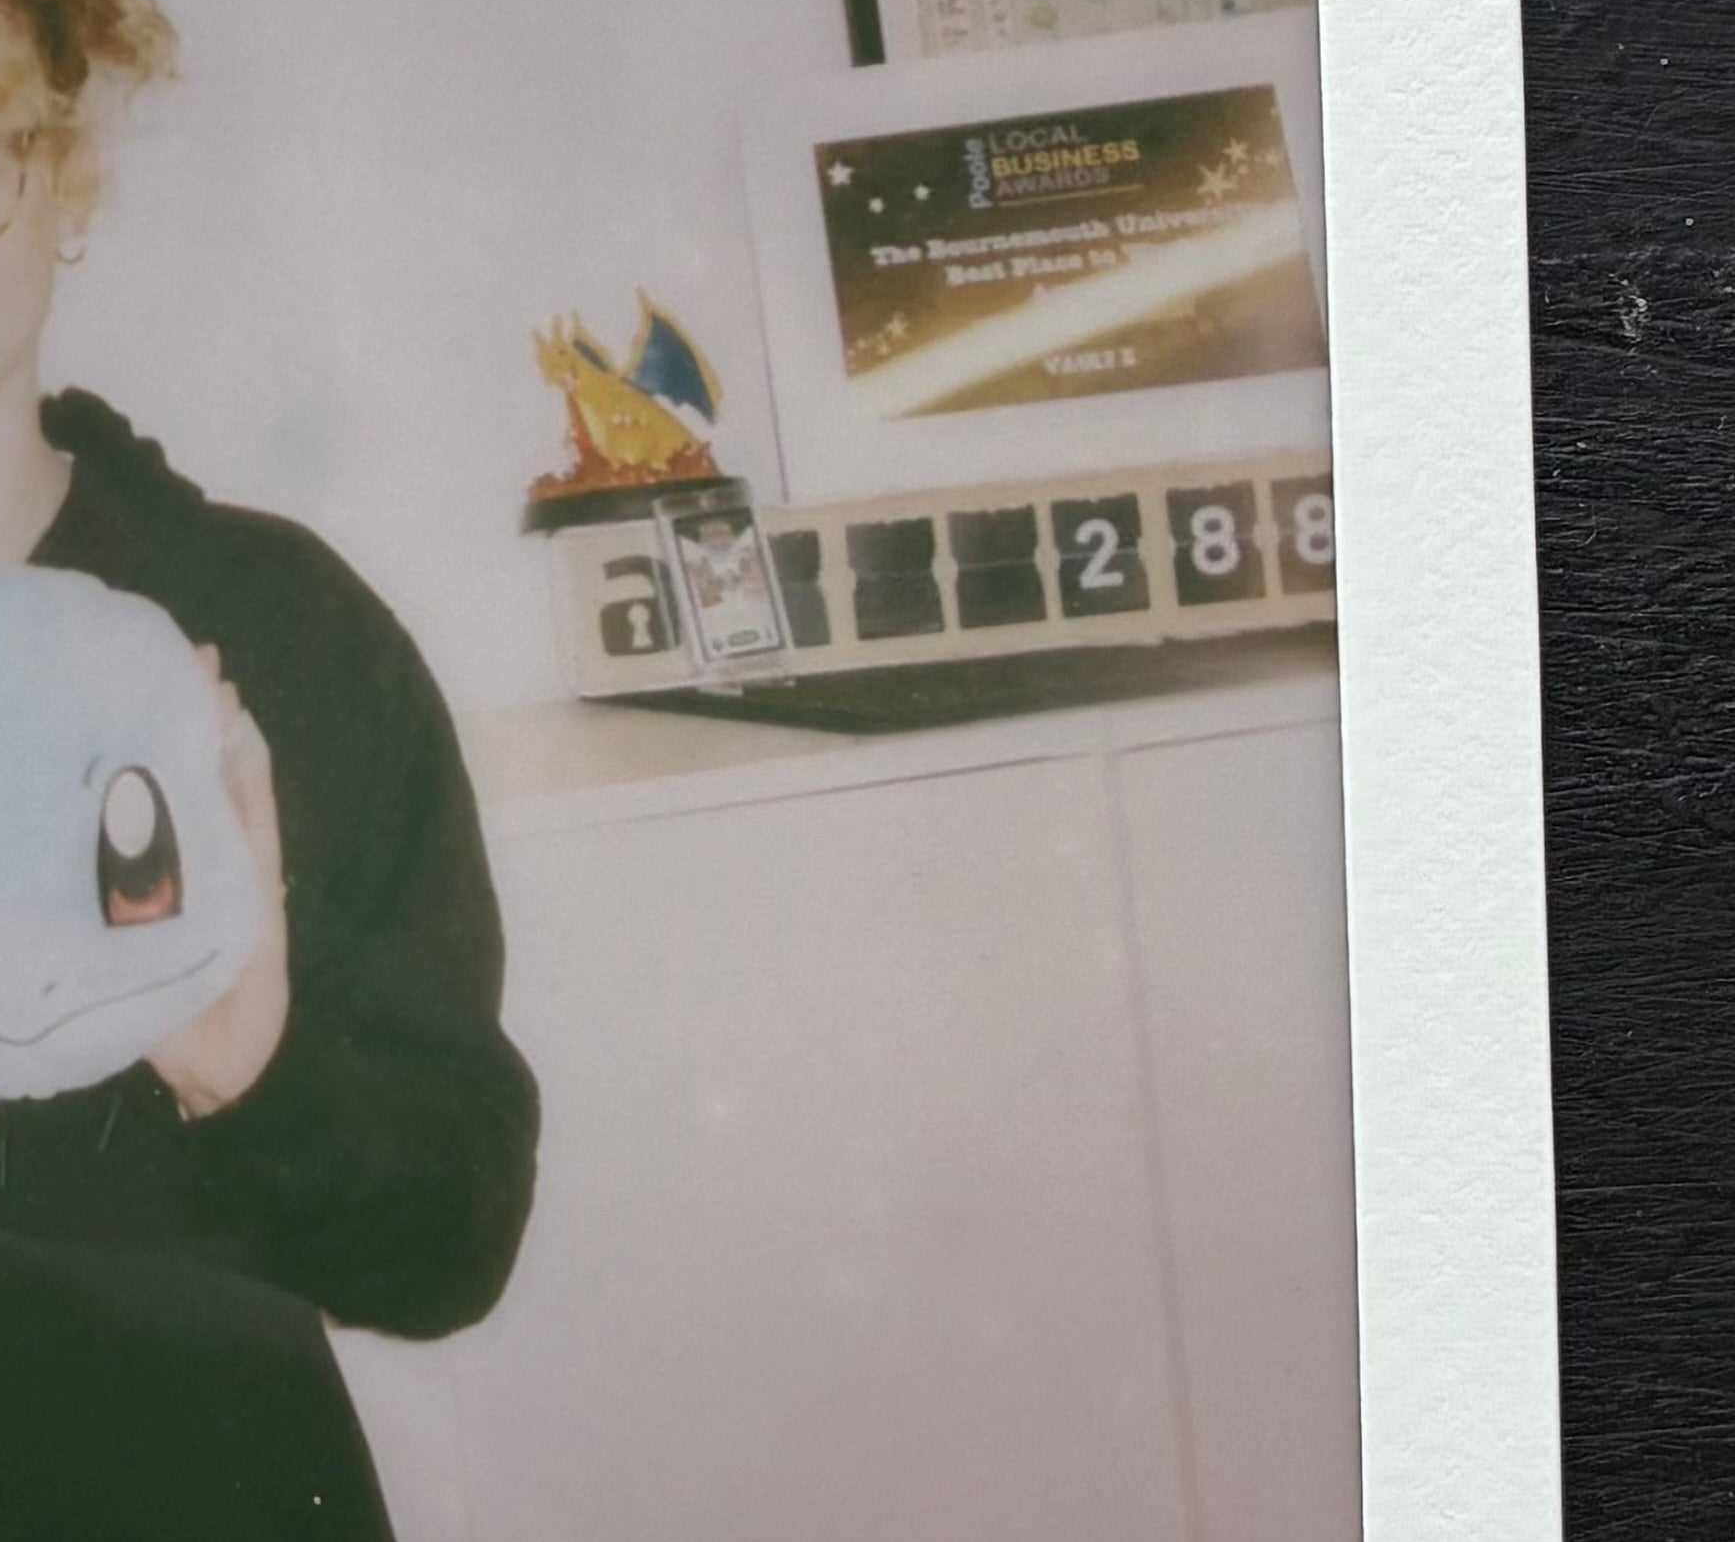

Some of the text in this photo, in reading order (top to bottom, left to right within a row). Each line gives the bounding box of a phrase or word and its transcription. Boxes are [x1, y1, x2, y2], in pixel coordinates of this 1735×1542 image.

[990, 124, 1086, 154] LOCAL
[964, 138, 993, 209] Poole
[991, 139, 1141, 178] BUSINESS
[995, 168, 1111, 198] AWARDS
[870, 244, 923, 266] The
[926, 217, 1111, 260] Bournemouth
[944, 260, 1005, 287] Best
[1011, 252, 1084, 278] Place
